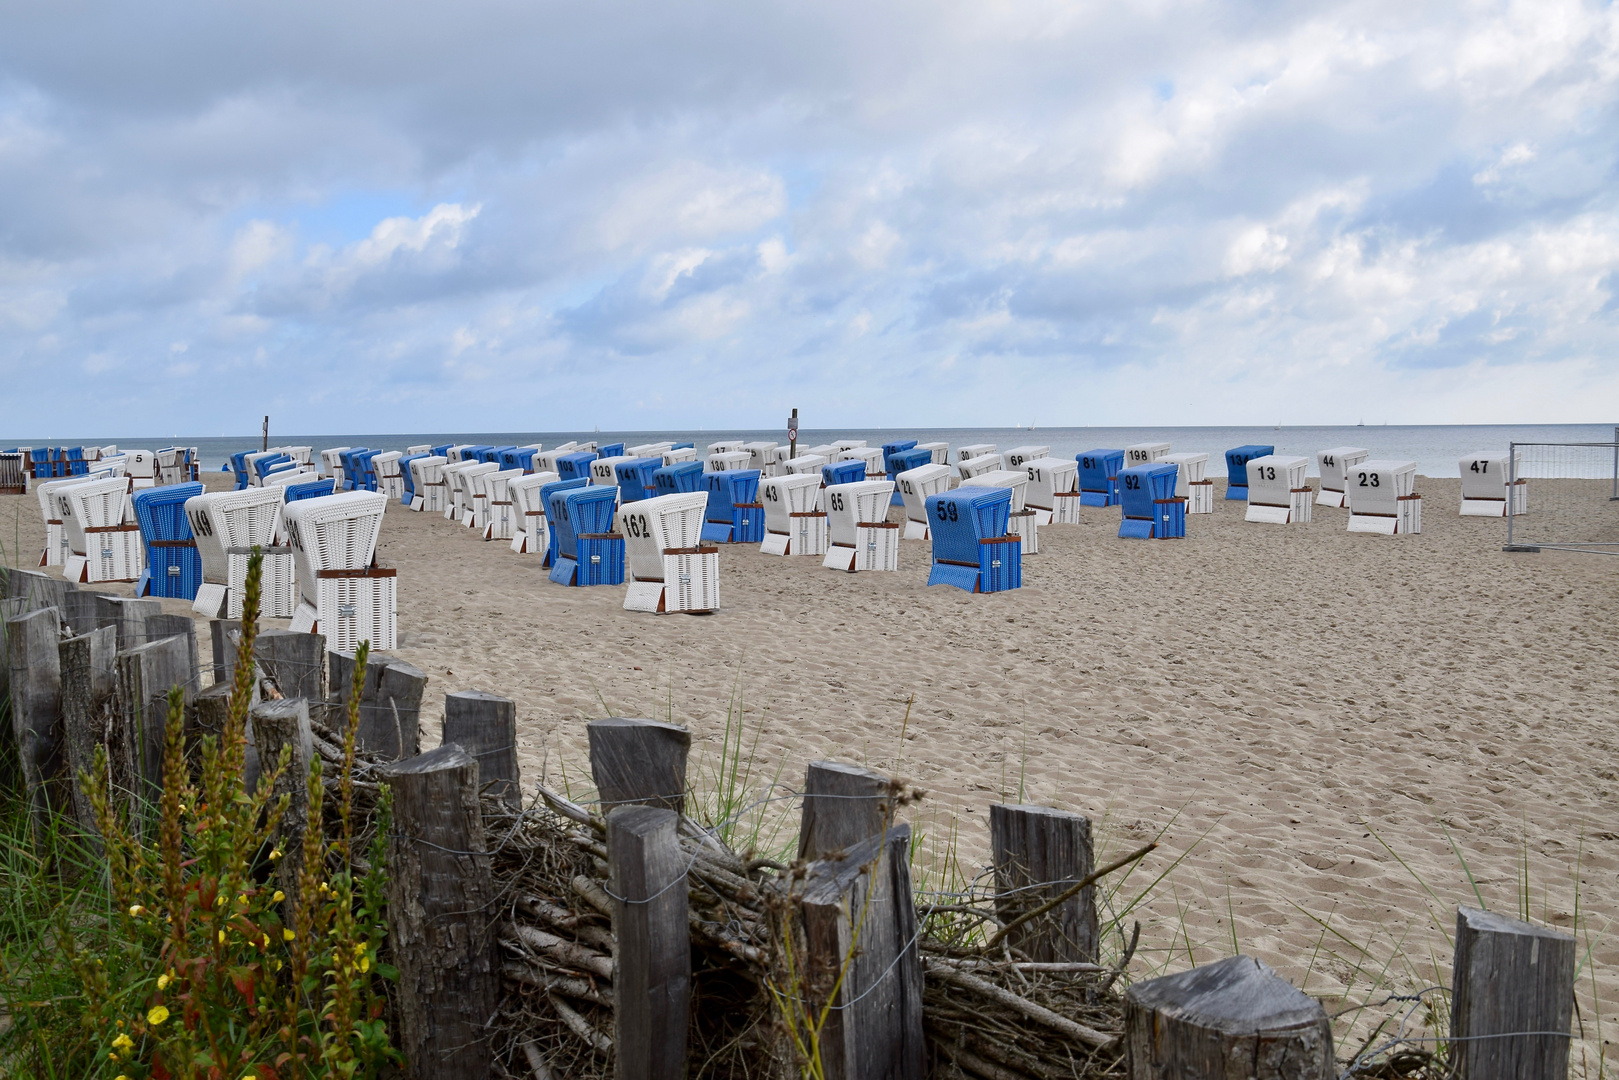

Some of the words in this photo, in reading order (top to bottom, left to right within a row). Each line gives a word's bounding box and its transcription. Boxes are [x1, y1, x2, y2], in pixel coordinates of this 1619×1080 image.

[135, 454, 143, 463] 5
[451, 451, 457, 460] 3
[537, 457, 547, 468] 11
[960, 450, 970, 461] 30
[1129, 450, 1148, 461] 198
[1323, 455, 1335, 467] 44
[559, 460, 574, 472] 103
[711, 460, 725, 471] 130
[891, 459, 906, 471] 169
[1083, 457, 1096, 469] 81
[1470, 460, 1489, 474] 47
[594, 465, 611, 478] 129
[618, 467, 637, 481] 141
[1027, 467, 1041, 482] 51
[1257, 466, 1276, 481] 13
[656, 474, 675, 489] 172
[708, 475, 721, 491] 71
[901, 479, 913, 495] 22
[1125, 475, 1141, 490] 92
[1358, 472, 1380, 488] 23
[765, 485, 778, 502] 43
[830, 493, 844, 511] 85
[551, 499, 568, 522] 176
[937, 500, 959, 522] 59
[188, 509, 213, 537] 149
[622, 514, 650, 539] 162
